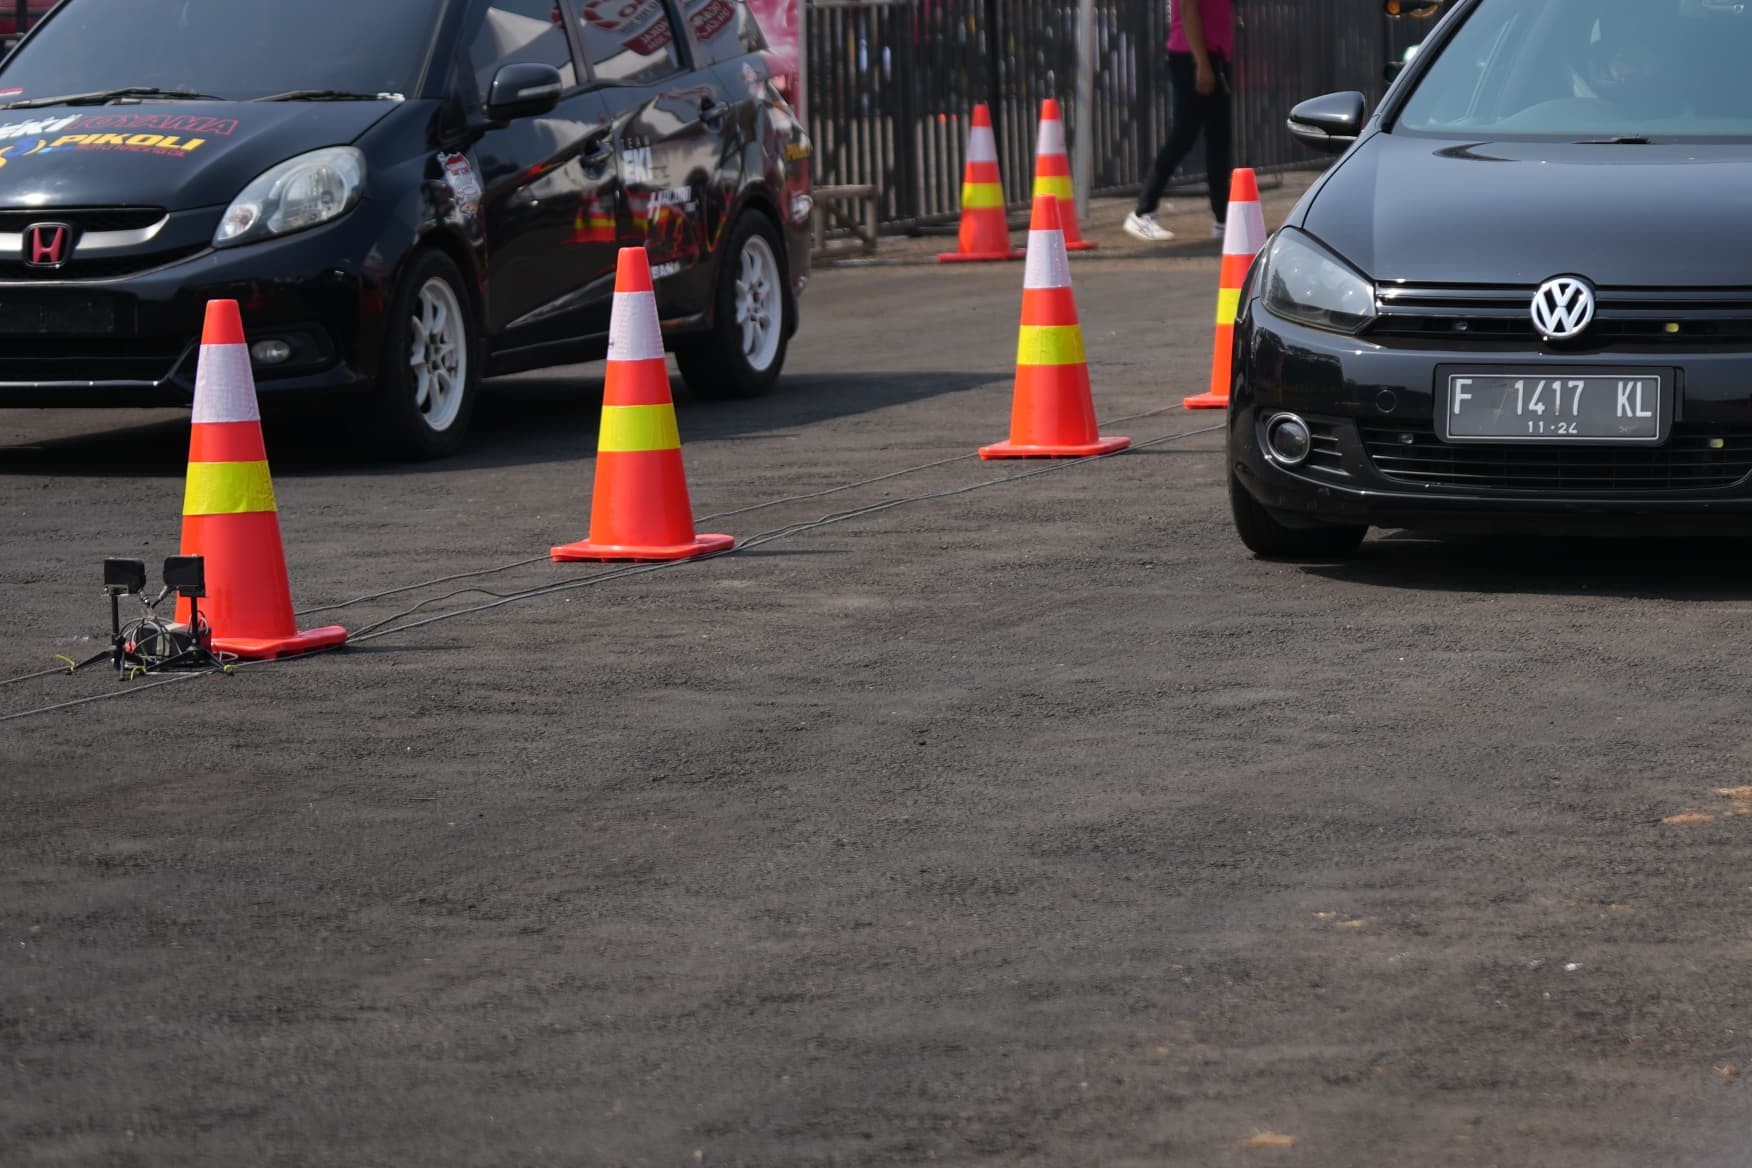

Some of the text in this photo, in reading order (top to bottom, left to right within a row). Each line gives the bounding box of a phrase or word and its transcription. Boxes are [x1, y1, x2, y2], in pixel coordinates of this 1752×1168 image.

[48, 133, 206, 152] PIKOLI
[1453, 378, 1652, 418] F 1417 KL
